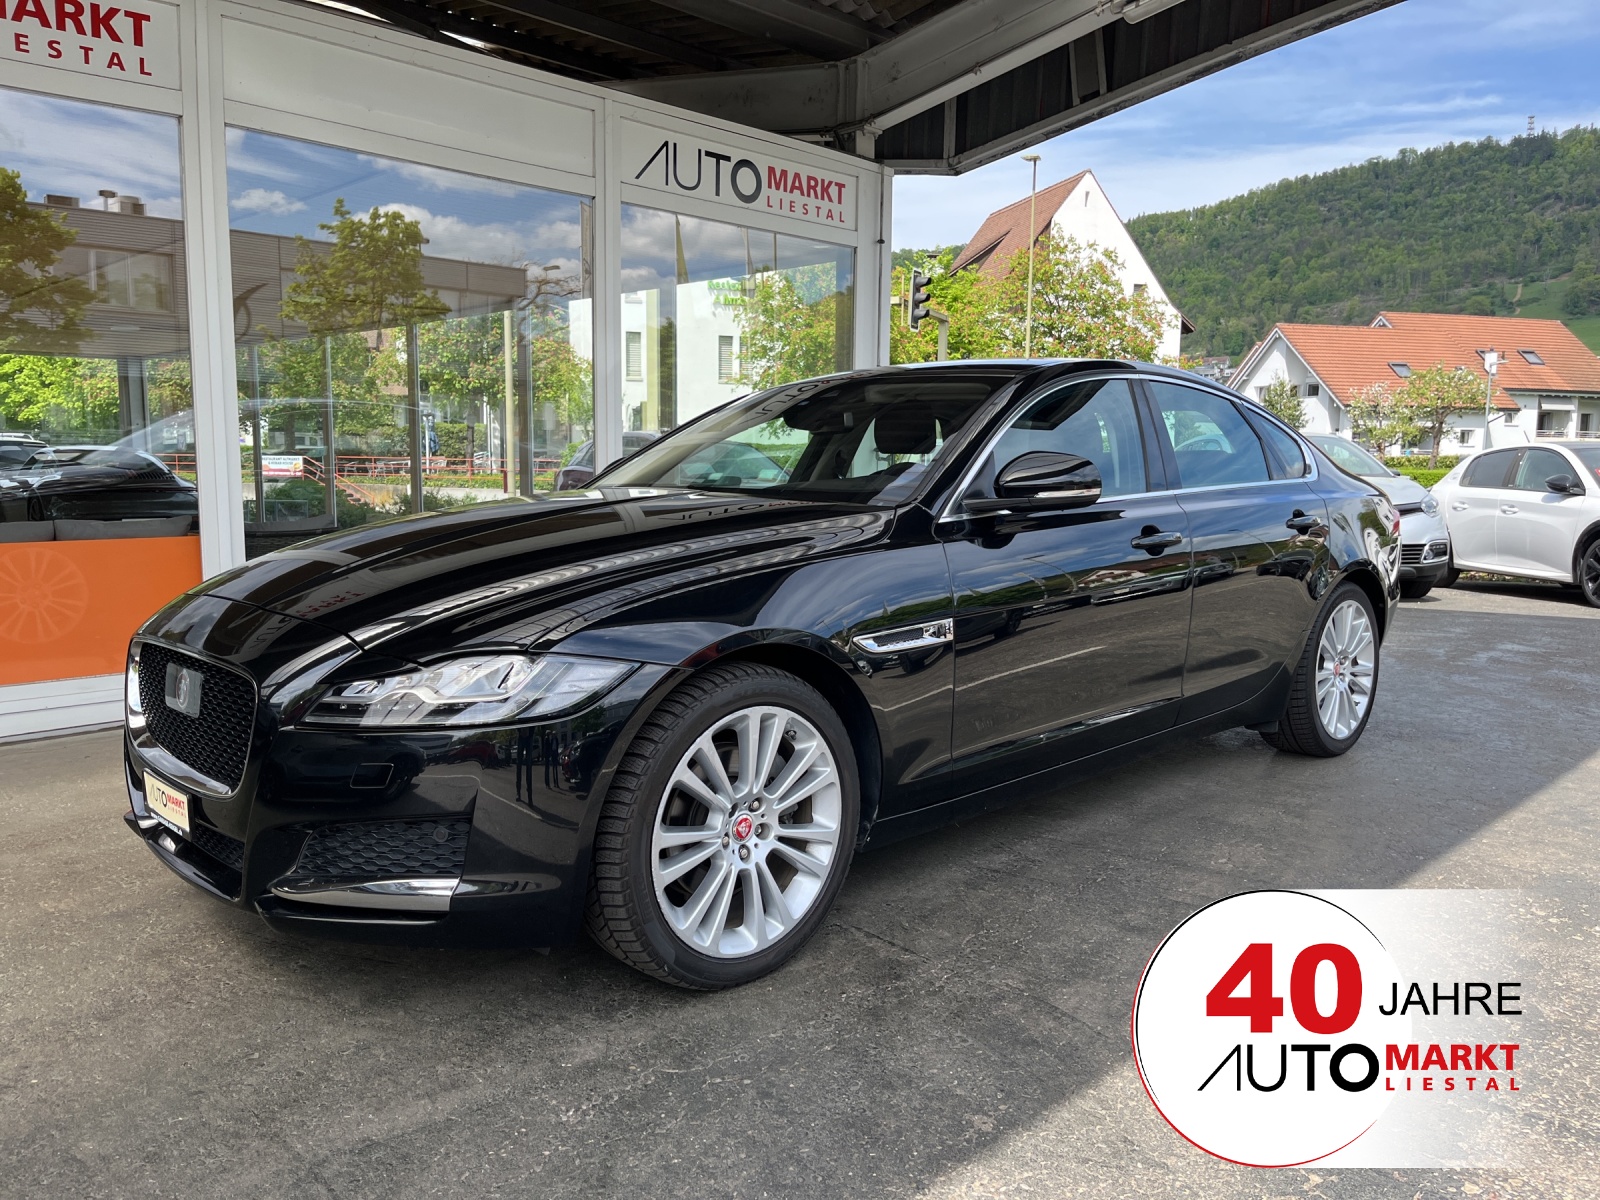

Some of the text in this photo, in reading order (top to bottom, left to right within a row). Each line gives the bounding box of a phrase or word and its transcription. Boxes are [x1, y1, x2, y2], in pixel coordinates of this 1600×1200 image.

[0, 0, 151, 47] ARKT
[15, 33, 152, 76] ESTAL
[767, 195, 845, 223] LIESTAL
